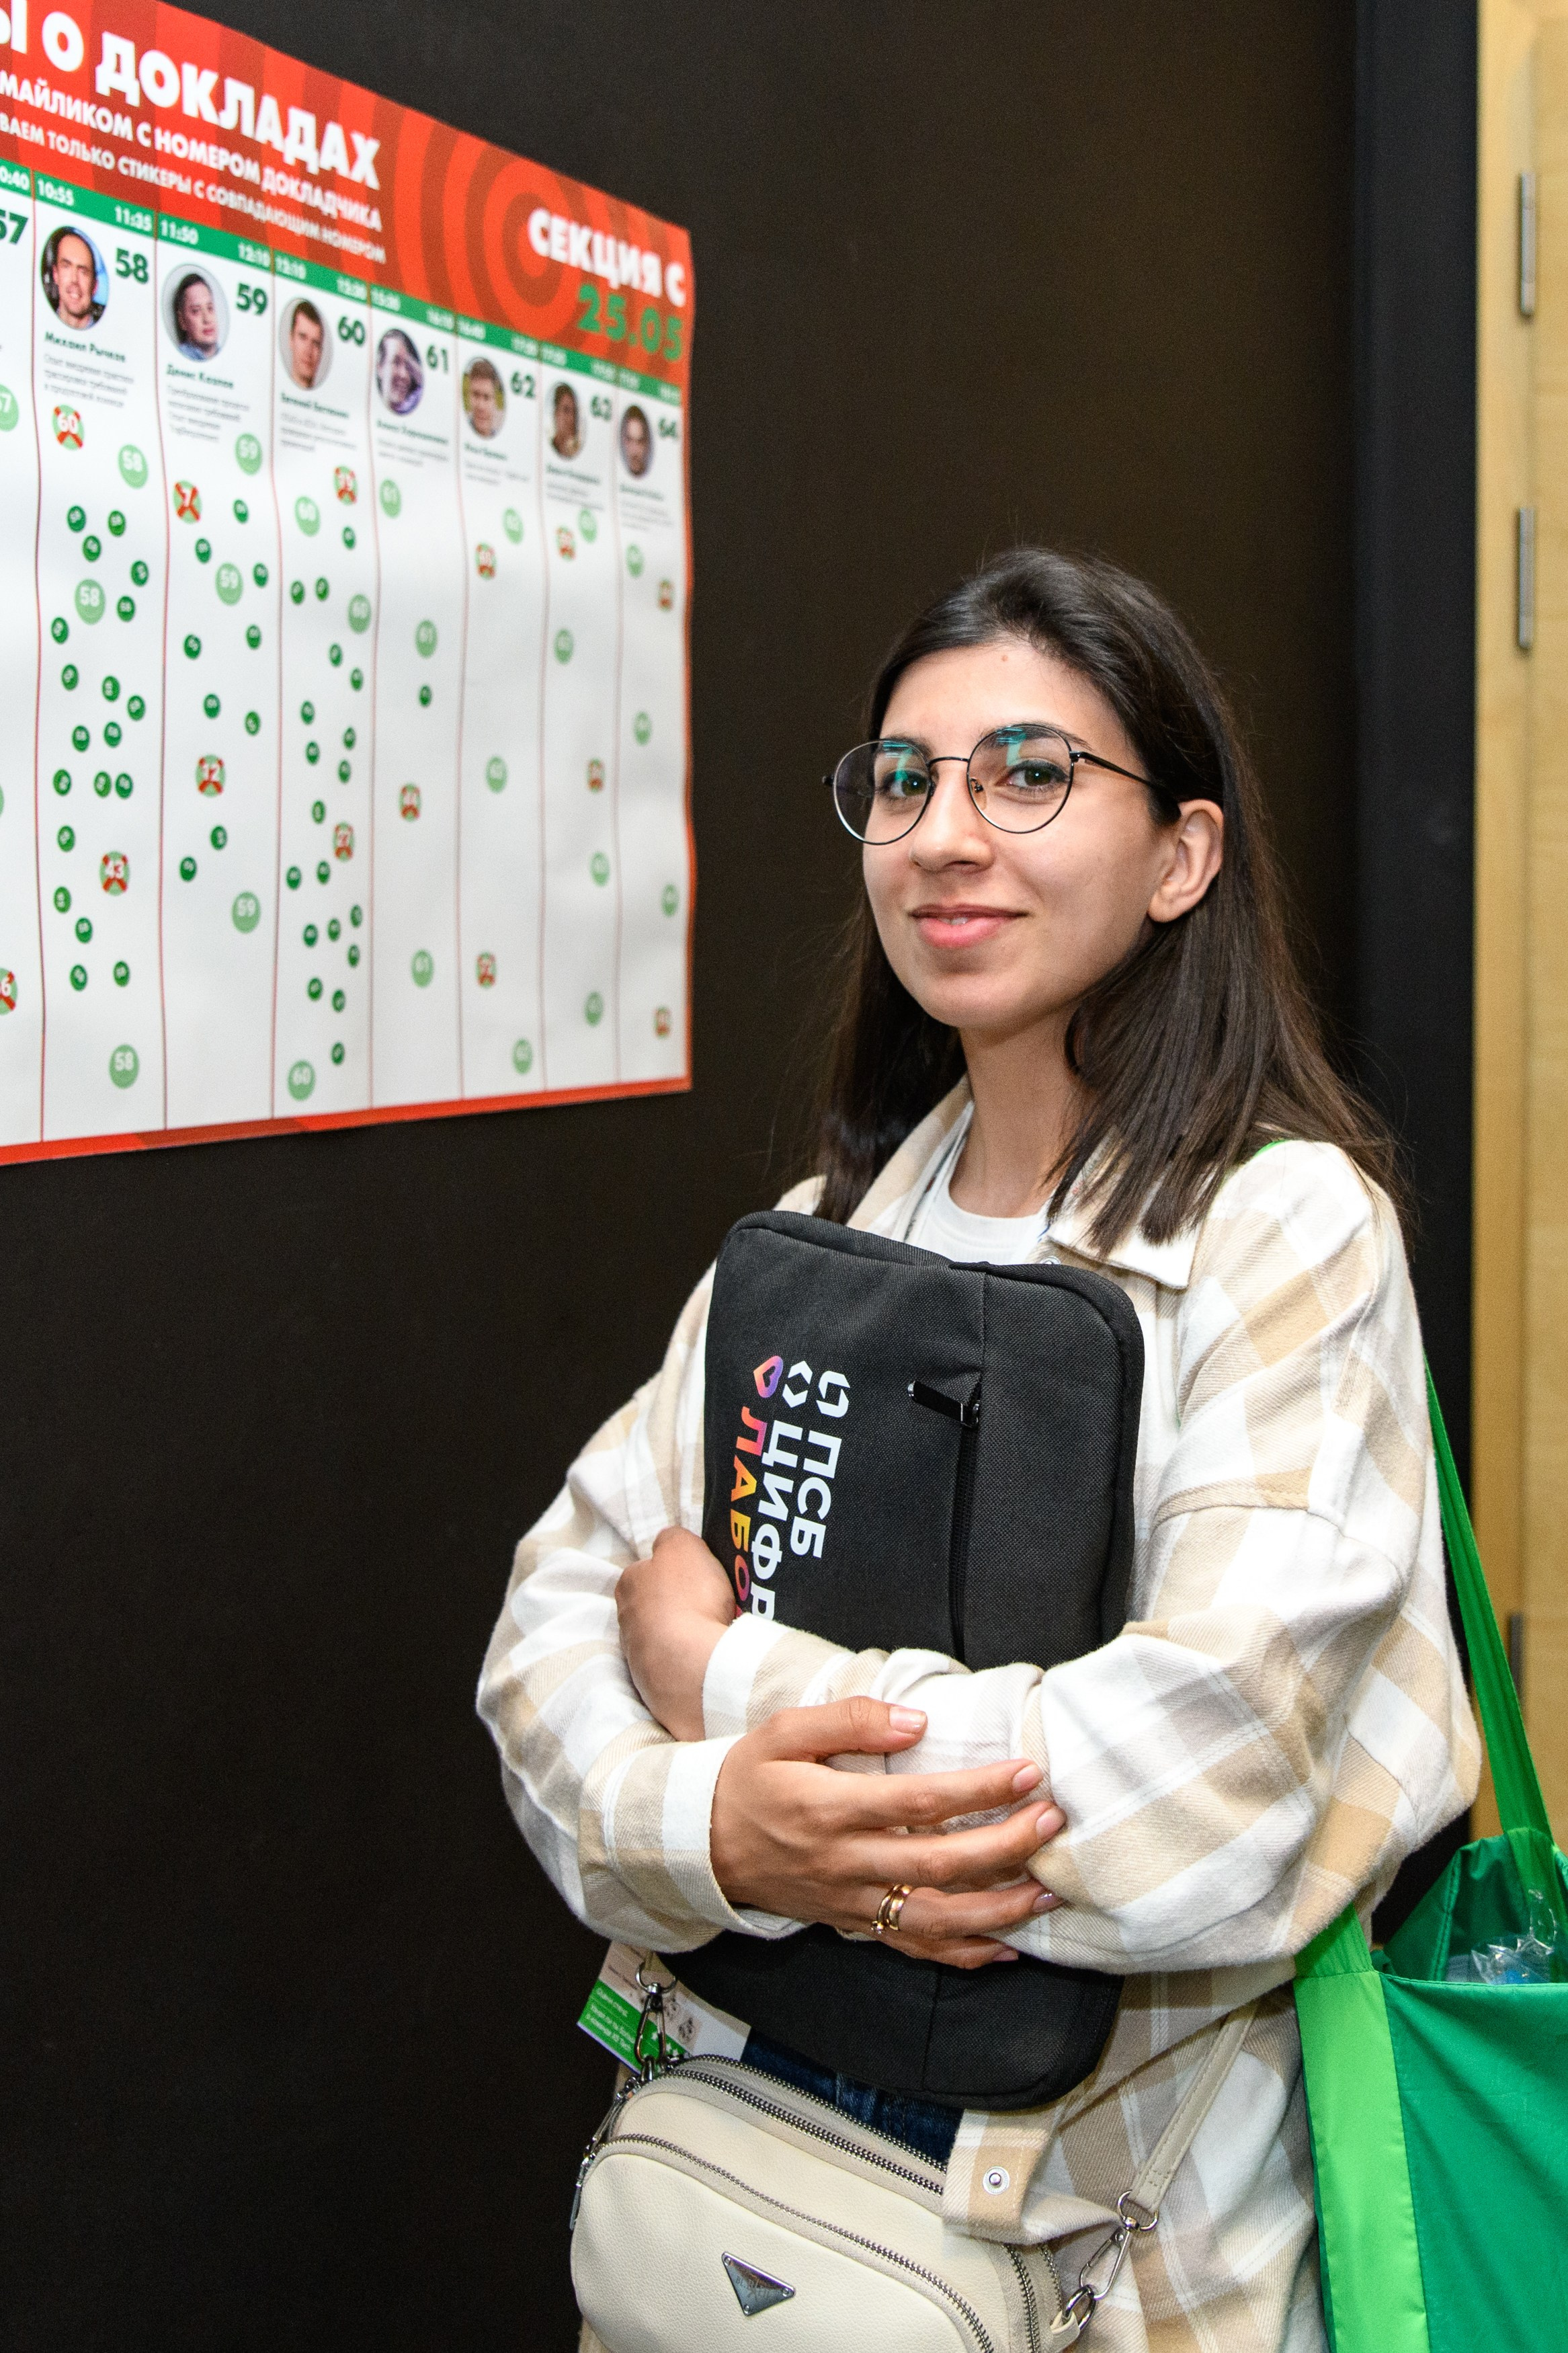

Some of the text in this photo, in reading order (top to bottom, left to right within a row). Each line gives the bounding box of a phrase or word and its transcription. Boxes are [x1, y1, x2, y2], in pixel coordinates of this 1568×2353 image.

[42, 11, 84, 72] О
[95, 31, 381, 190] ДОКЛАДАХ
[0, 70, 382, 232] МАЙЛИКОМ С НОМЕРОМ ДОКЛАДЧИКА
[38, 180, 75, 206] 10:55
[48, 130, 115, 169] ТОЛЬКО
[118, 156, 192, 195] СТИКЕРЫ
[194, 180, 206, 200] С
[321, 227, 386, 264] НОМЕРОМ
[116, 247, 149, 284] 58
[528, 208, 686, 308] СЕКЦИЯ С
[236, 282, 269, 316] 59
[337, 316, 366, 346] 60
[577, 284, 684, 362] 25.05
[426, 345, 449, 374] 61
[0, 393, 11, 413] 7
[510, 371, 536, 399] 62
[590, 394, 612, 422] 63
[730, 1406, 768, 1617] ЛАБО
[790, 1430, 842, 1558] ПСБ
